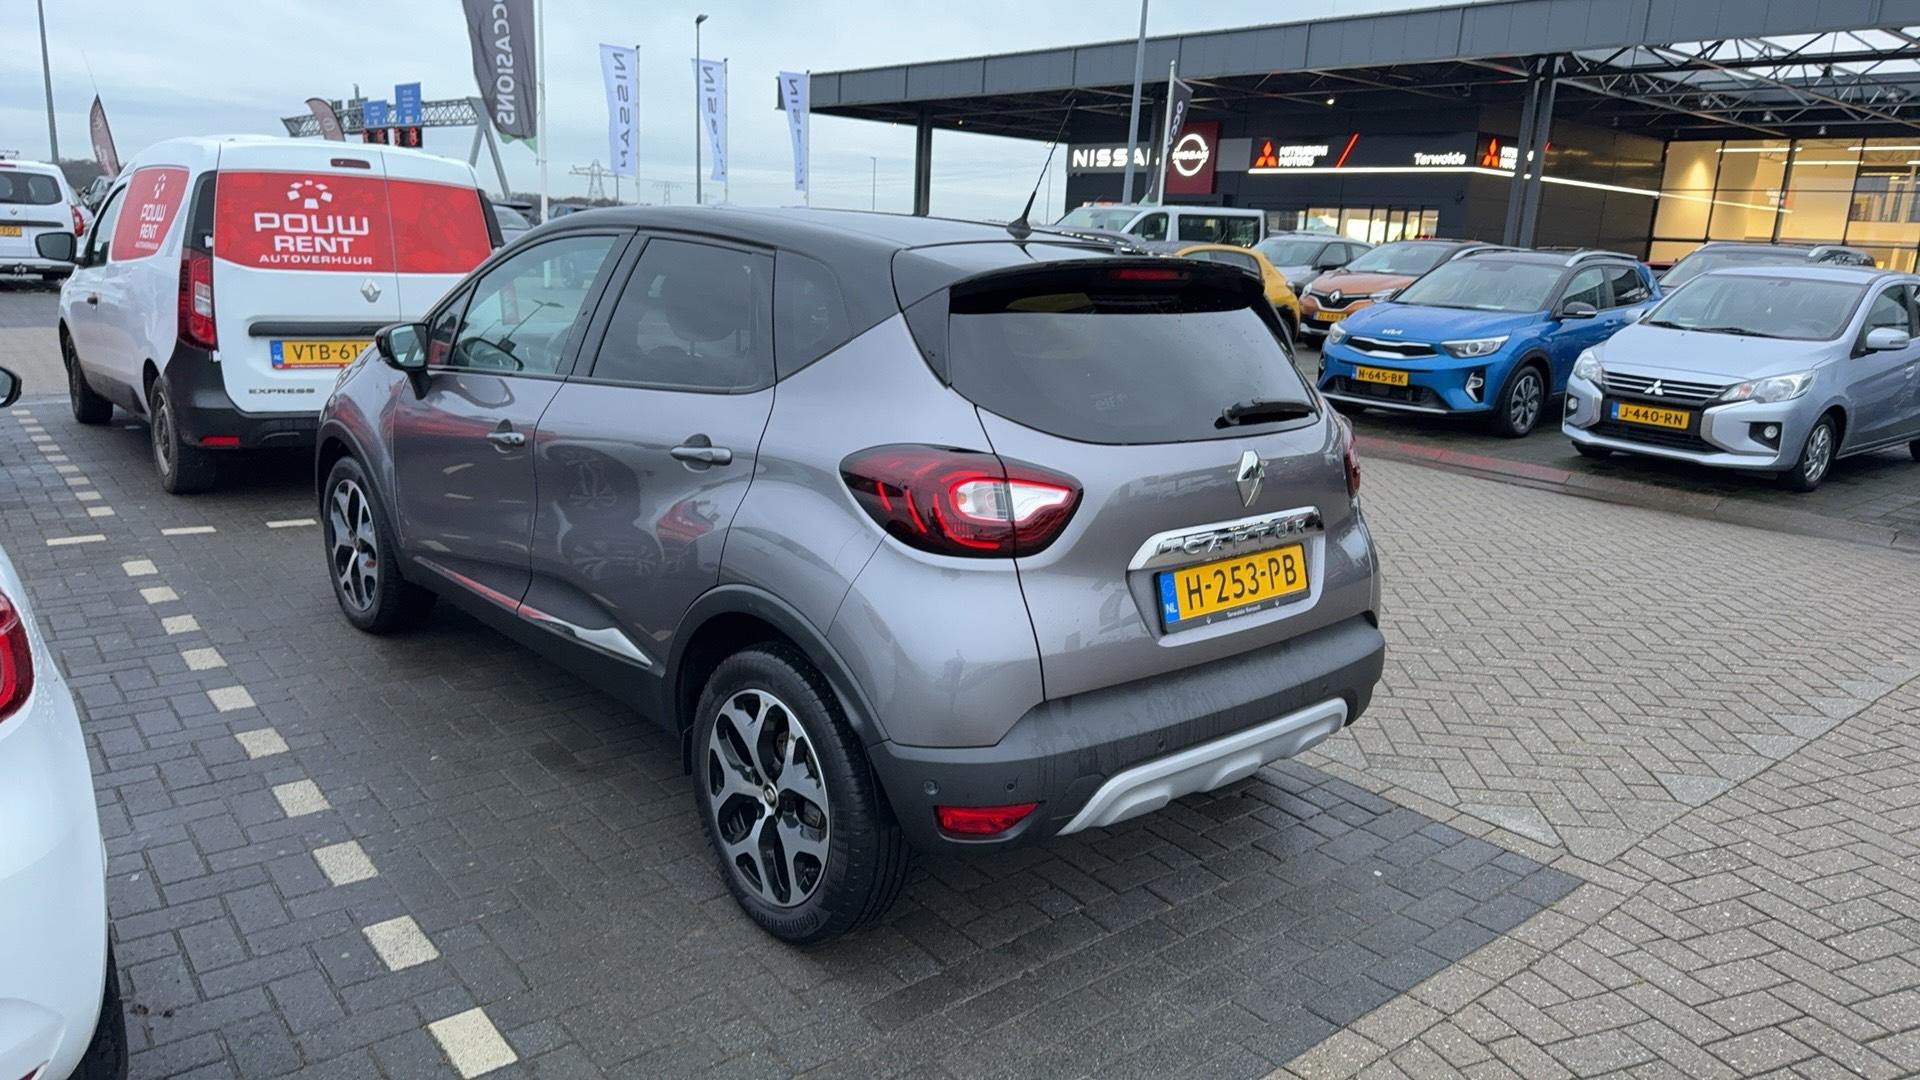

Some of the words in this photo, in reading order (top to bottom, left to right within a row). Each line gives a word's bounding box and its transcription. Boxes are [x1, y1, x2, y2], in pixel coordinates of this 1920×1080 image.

[1413, 151, 1467, 165] Terwolde
[140, 203, 167, 221] POUW
[254, 212, 369, 235] POUW
[274, 235, 354, 253] RENT
[258, 254, 373, 265] AUTOVERHUUR
[1358, 368, 1405, 384] N-645-BK
[1621, 406, 1683, 426] J-440-RN
[1186, 554, 1298, 610] H-253-PB
[1165, 602, 1178, 614] NL
